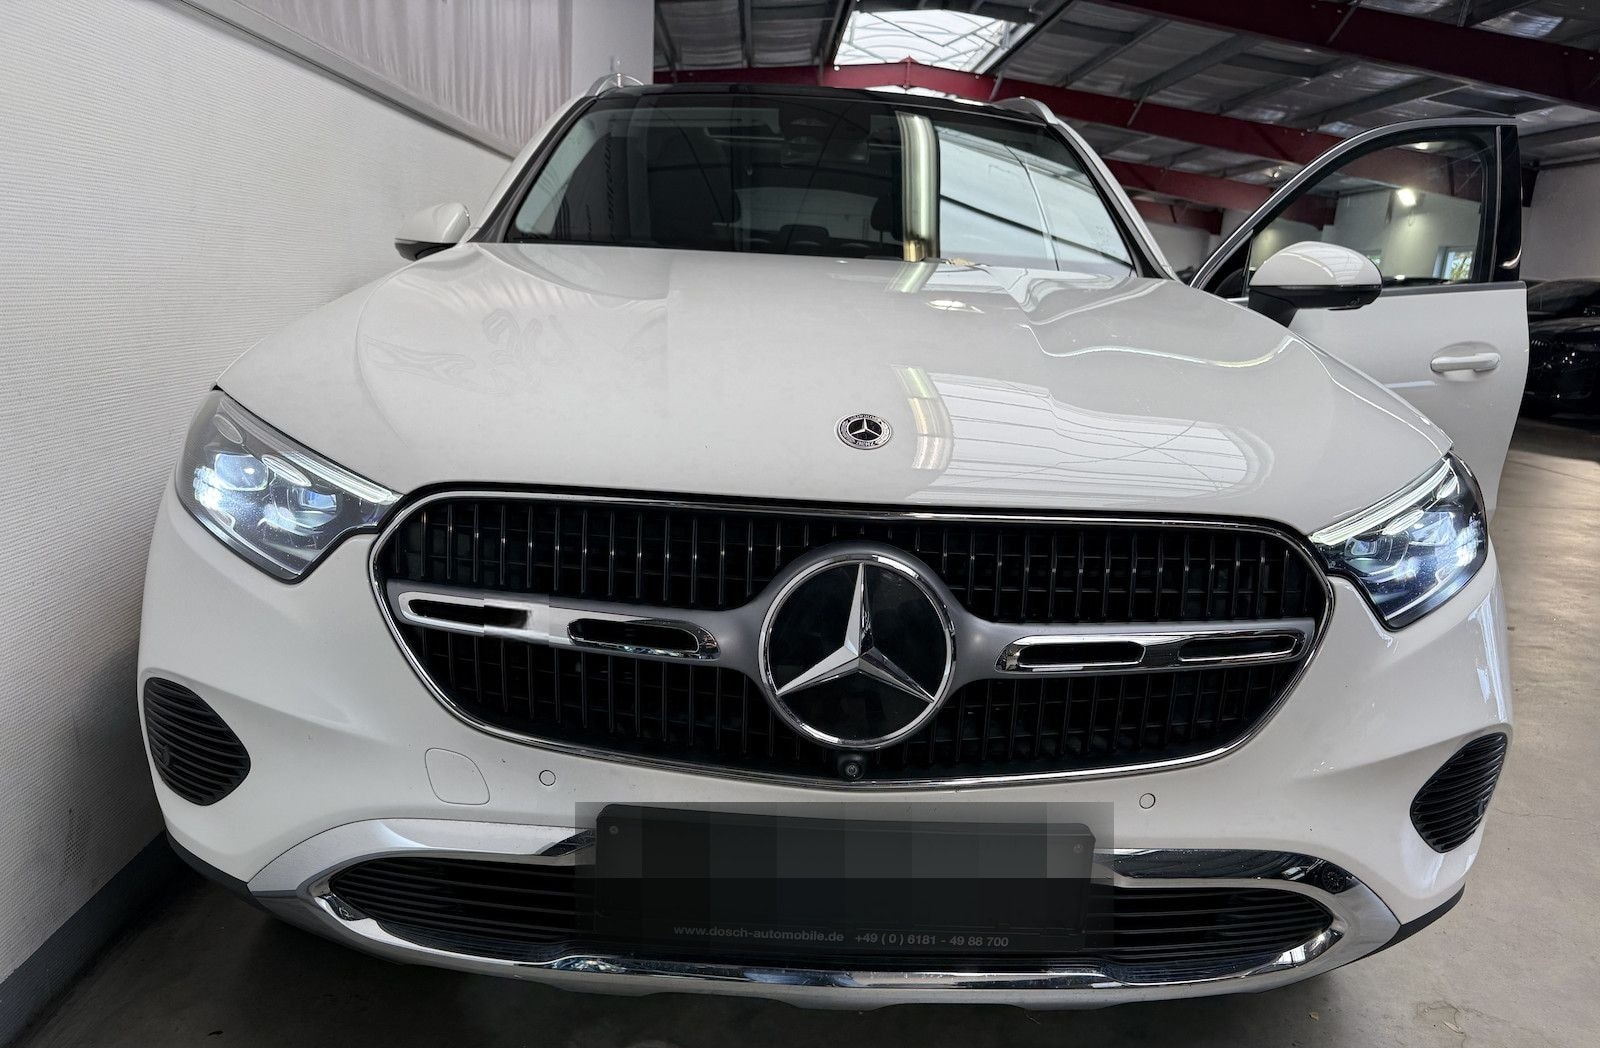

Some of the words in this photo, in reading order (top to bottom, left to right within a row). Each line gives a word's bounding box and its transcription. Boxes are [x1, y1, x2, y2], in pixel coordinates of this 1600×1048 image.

[673, 925, 845, 942] www.dosch-automobile.de
[855, 932, 878, 943] +49
[907, 934, 936, 945] 6181
[949, 935, 965, 946] 49
[967, 936, 983, 947] 88
[987, 936, 1009, 947] 700
